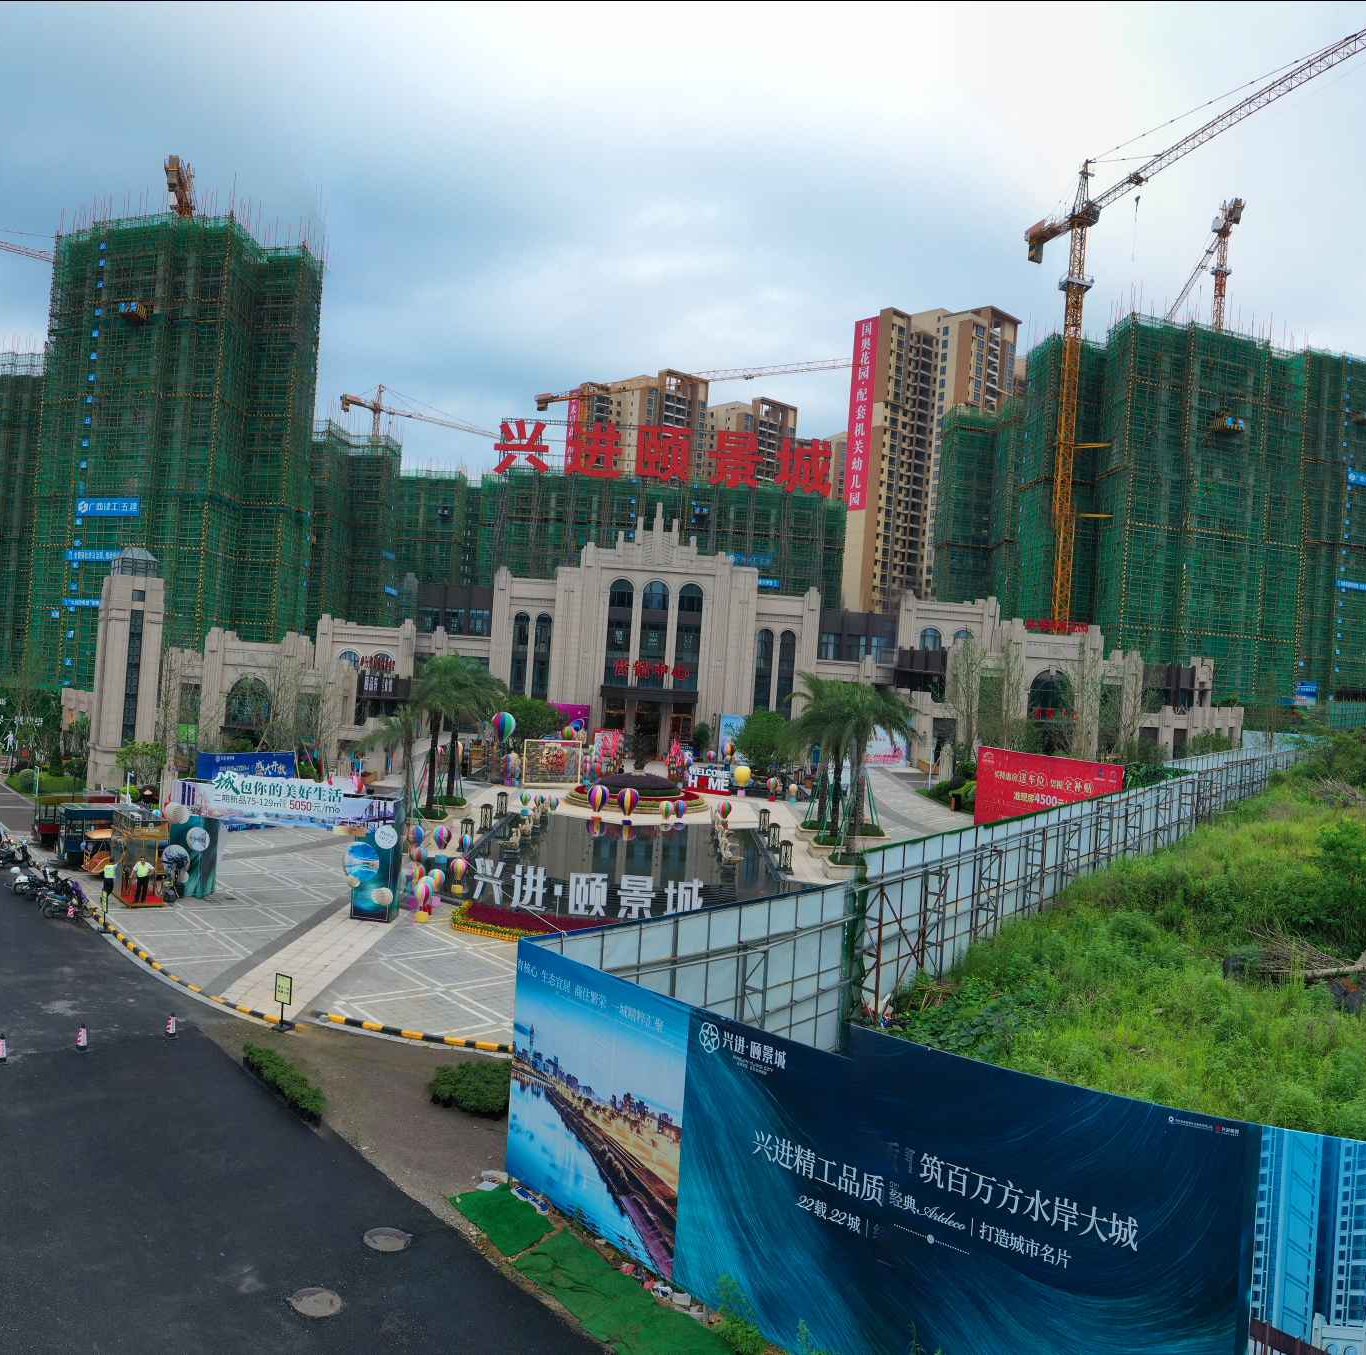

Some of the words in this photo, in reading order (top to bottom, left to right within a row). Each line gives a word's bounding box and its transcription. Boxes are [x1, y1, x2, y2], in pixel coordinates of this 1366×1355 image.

[493, 420, 832, 497] 兴进颐景城
[688, 766, 730, 778] WELCOME
[473, 858, 704, 919] 兴进·颐景城
[722, 1031, 787, 1069] 兴进·颐景城
[752, 1129, 884, 1207] 兴进精工品质
[919, 1151, 1139, 1252] 筑百万方水岸大城
[979, 1221, 1072, 1269] 打造城市名片
